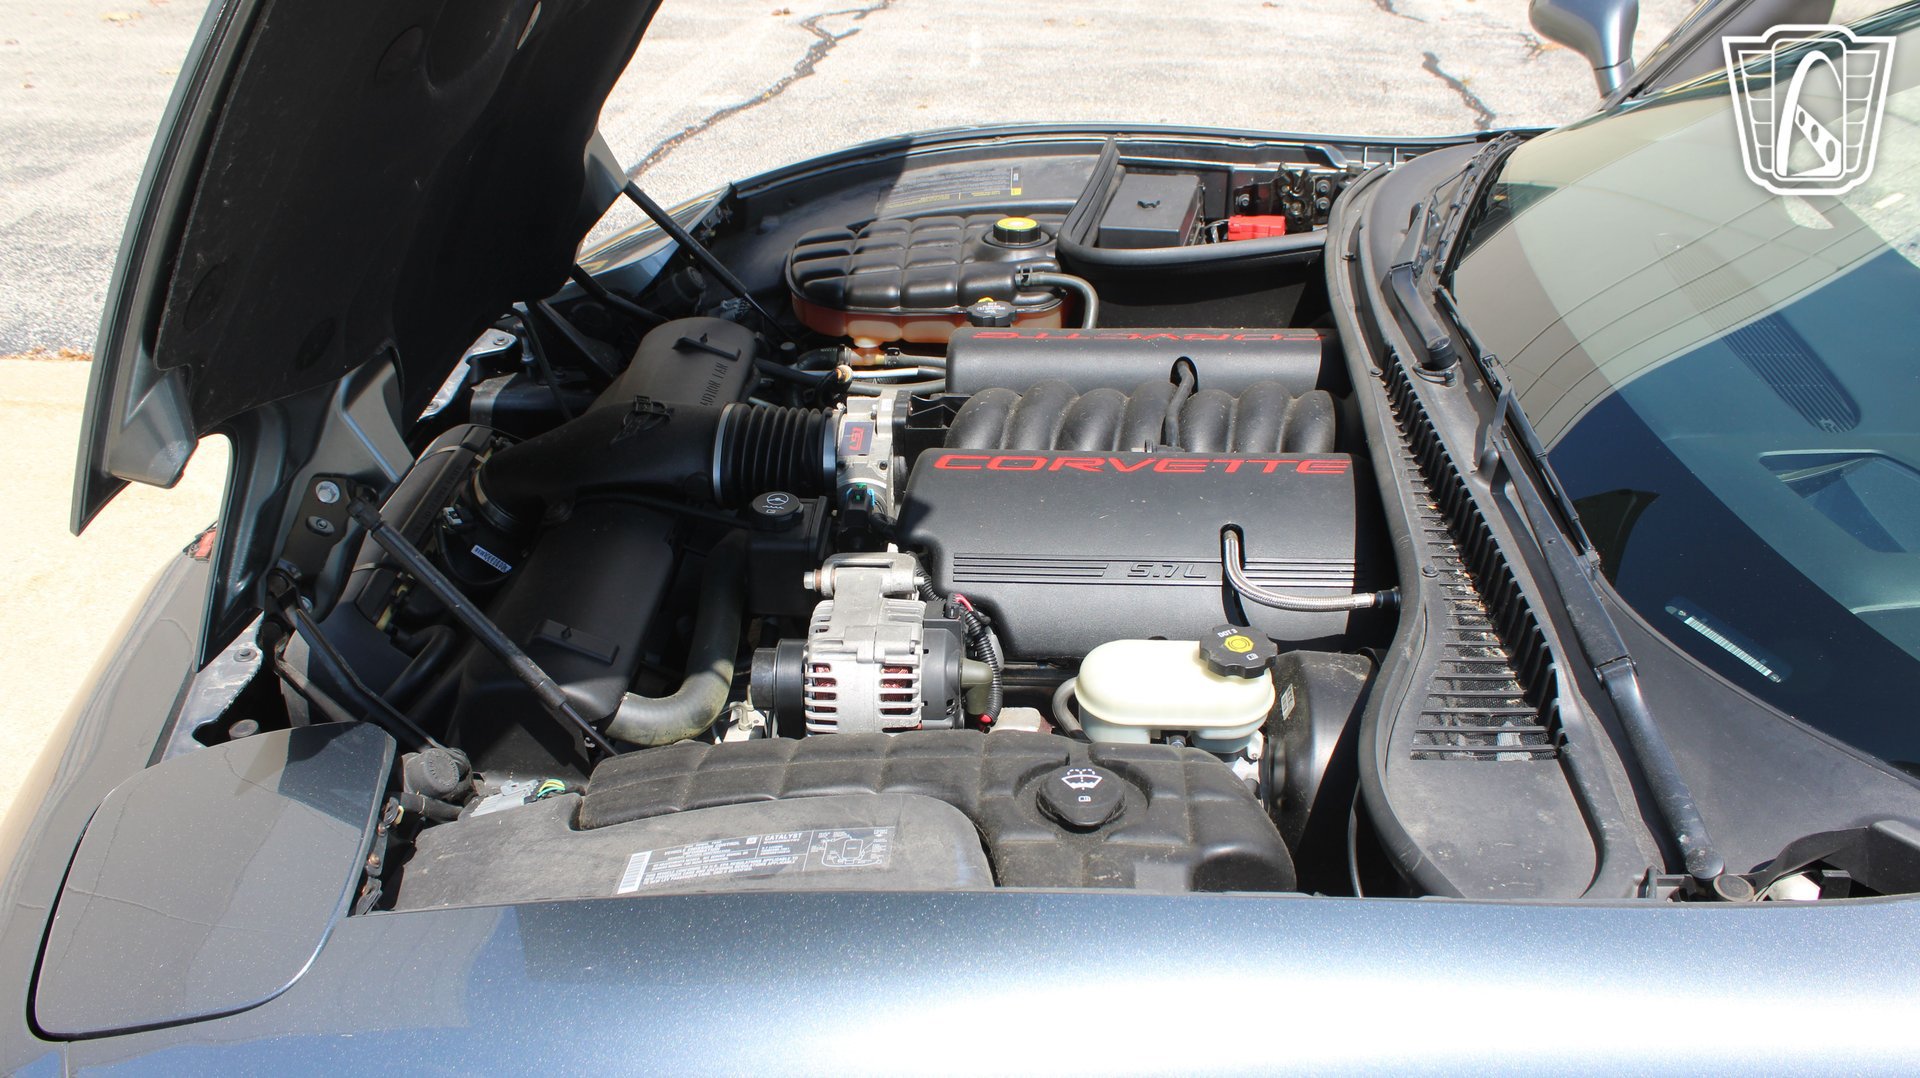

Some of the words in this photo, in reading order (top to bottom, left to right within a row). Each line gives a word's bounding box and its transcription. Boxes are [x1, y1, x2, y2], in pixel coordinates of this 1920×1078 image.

[934, 453, 1351, 474] CORVETTE
[1127, 563, 1207, 579] 5.7L
[1217, 629, 1232, 638] DOT
[764, 832, 802, 841] CATALYST
